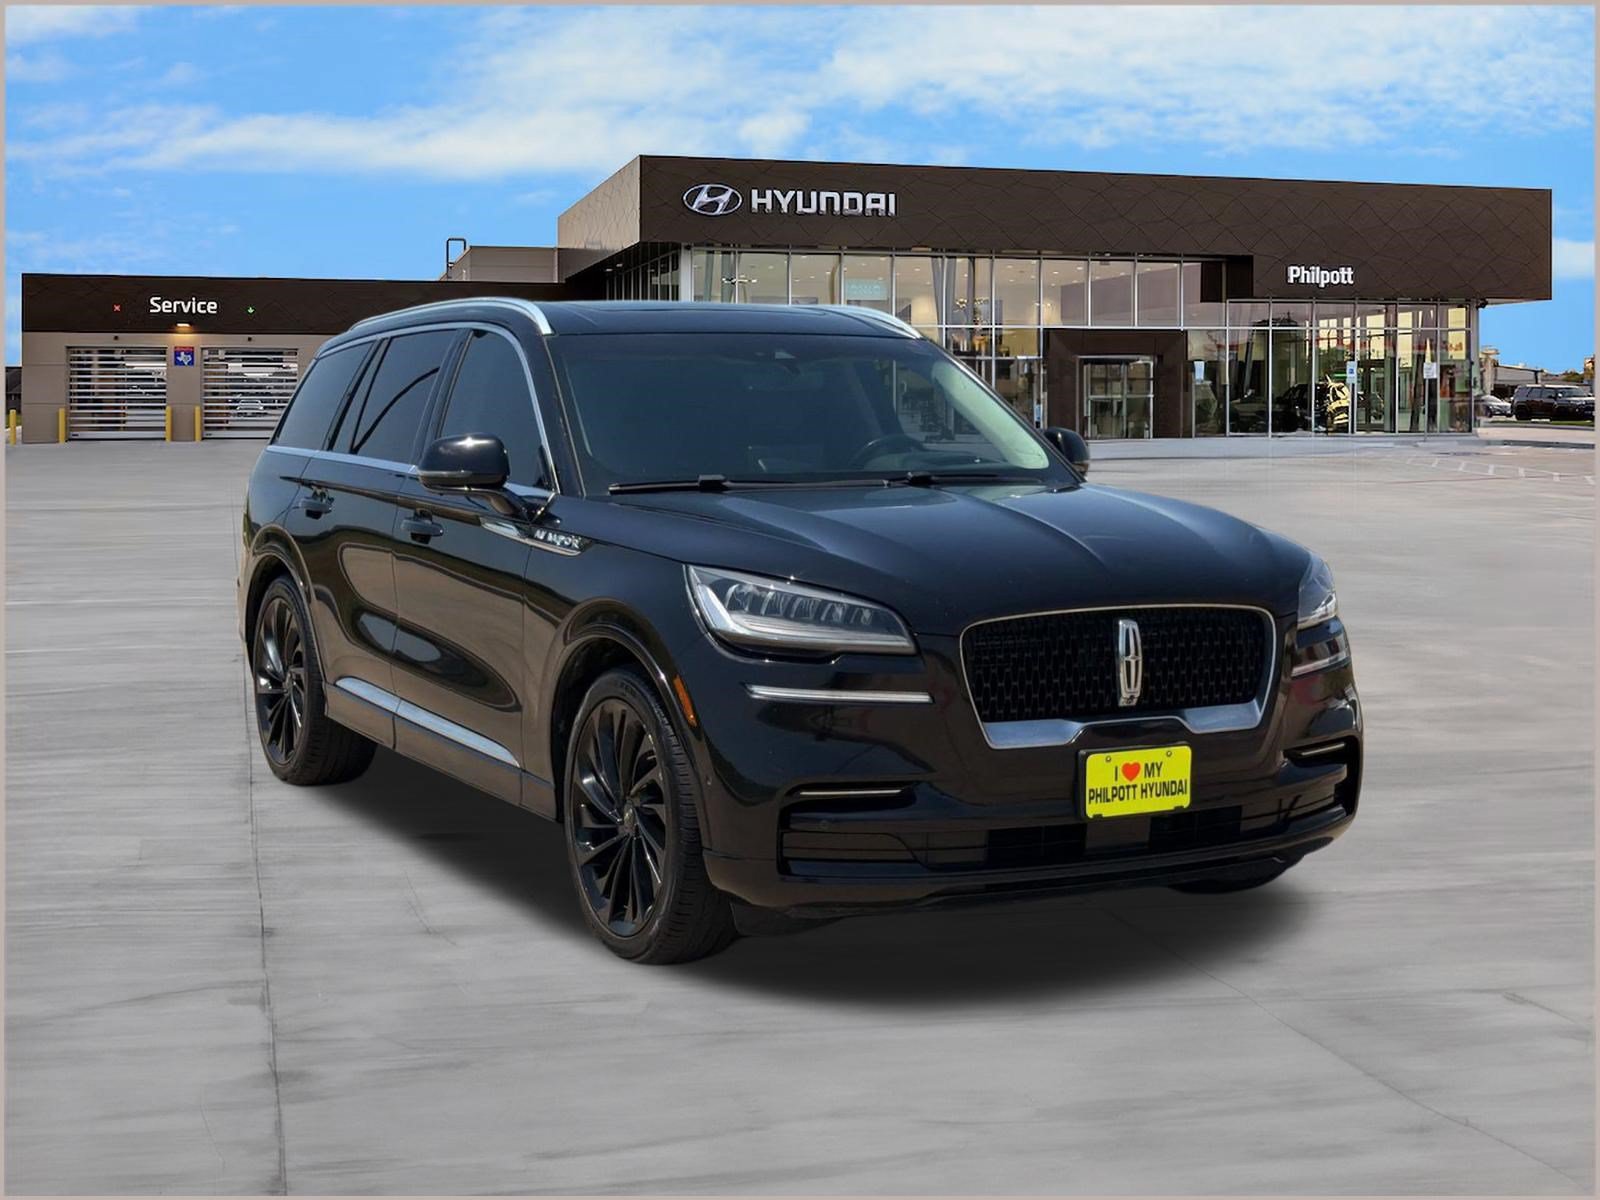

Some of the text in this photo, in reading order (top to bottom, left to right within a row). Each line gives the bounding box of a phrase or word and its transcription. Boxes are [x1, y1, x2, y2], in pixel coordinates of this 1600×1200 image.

[751, 189, 897, 216] HYUNDAI
[1287, 265, 1355, 288] Philpott
[149, 296, 218, 314] Service
[1114, 761, 1164, 782] I MY
[1088, 779, 1188, 804] PHILPOTT HYUNDAI
